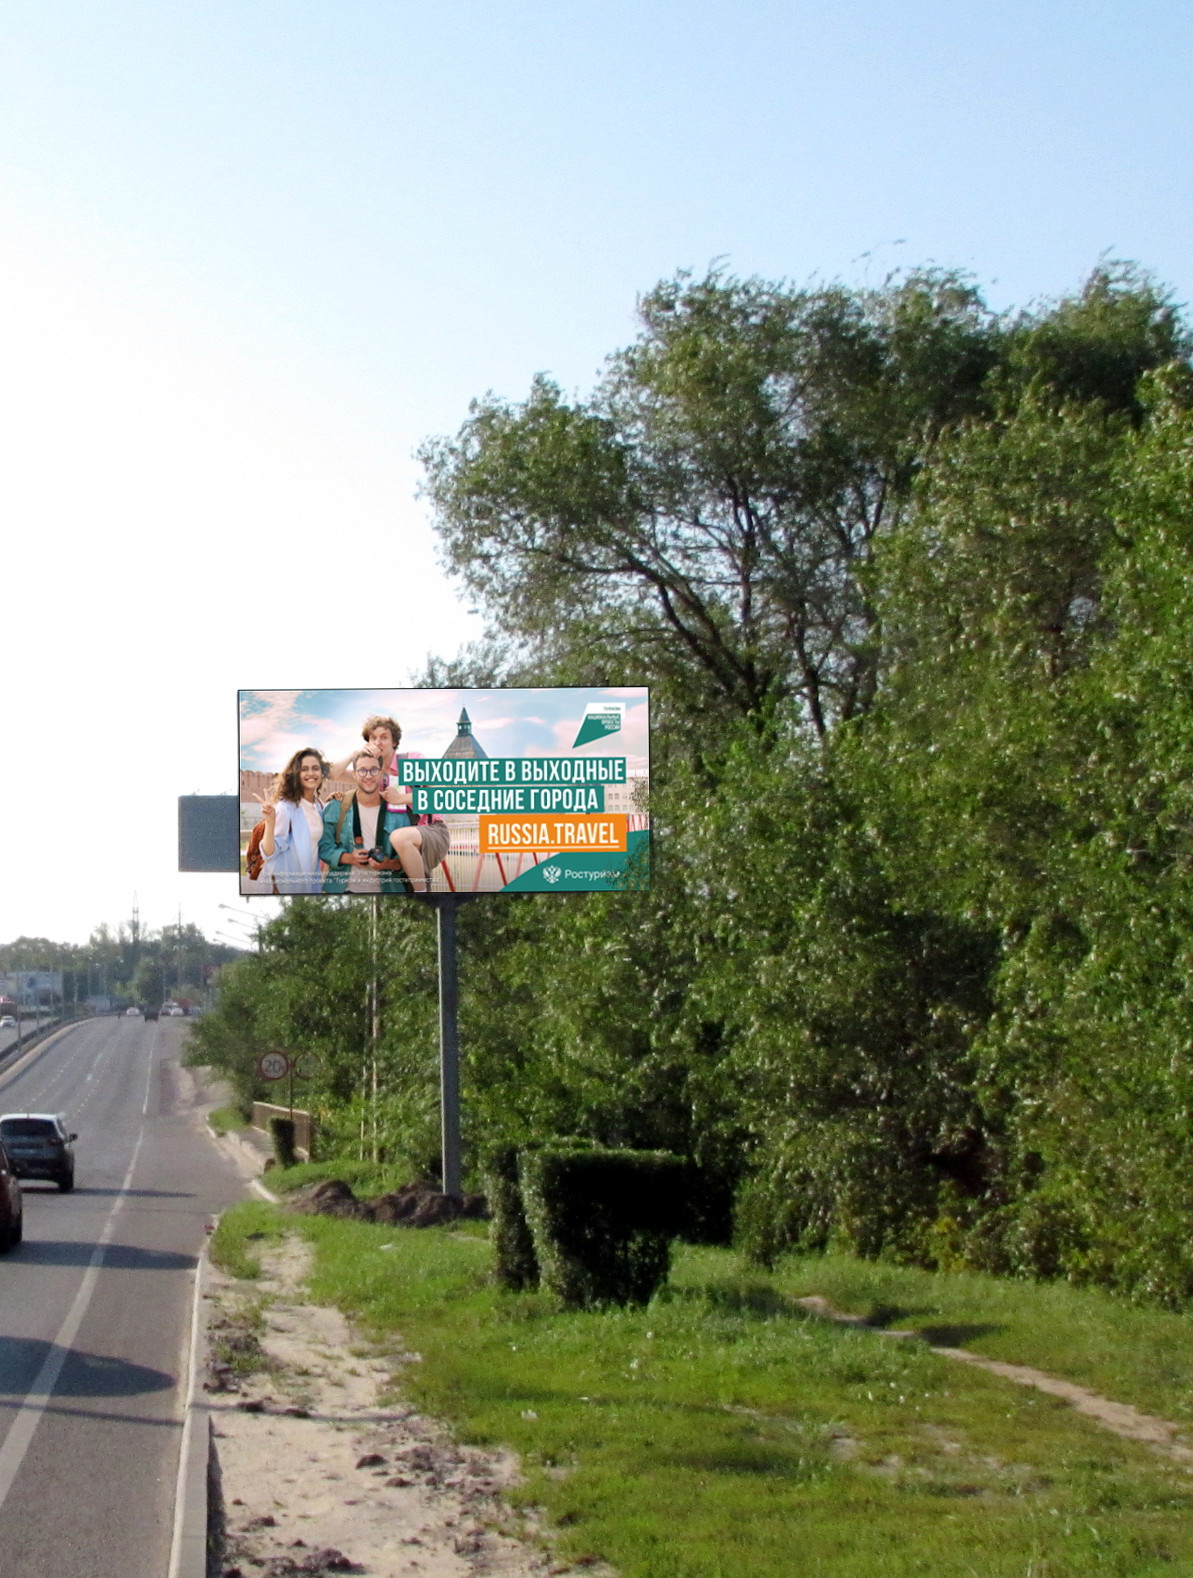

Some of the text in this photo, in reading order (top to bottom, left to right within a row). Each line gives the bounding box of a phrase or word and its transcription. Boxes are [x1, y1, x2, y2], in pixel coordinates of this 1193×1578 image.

[402, 759, 624, 785] ВЫХОДИТЕ В ВЫХОДНЫЕ
[417, 788, 599, 813] В СОСЕДНИЕ ГОРОДА
[487, 822, 620, 845] RUSSIA.TRAVEL
